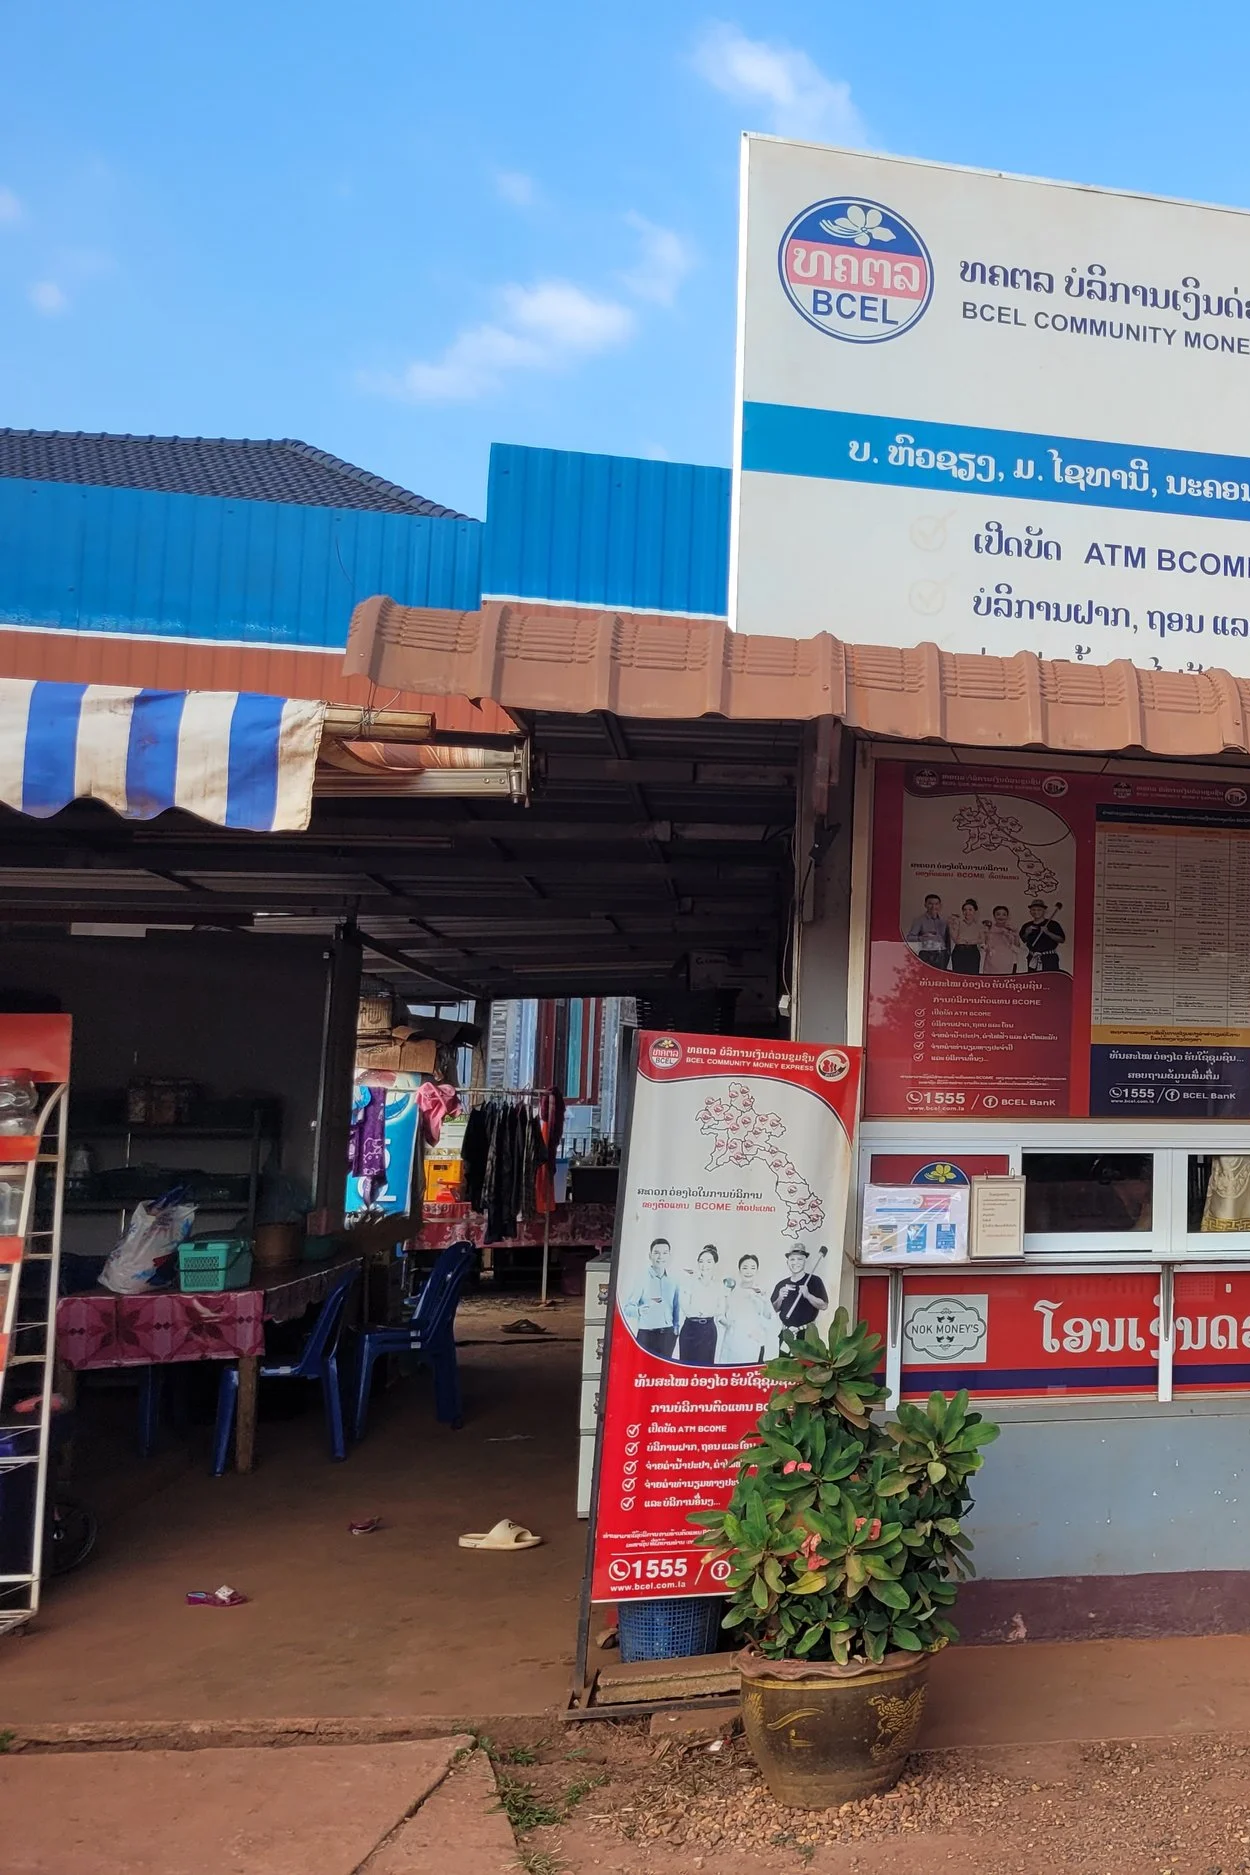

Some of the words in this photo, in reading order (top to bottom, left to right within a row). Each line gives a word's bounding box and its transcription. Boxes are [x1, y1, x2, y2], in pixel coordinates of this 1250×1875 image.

[793, 247, 920, 292] ທຄຕລ
[959, 259, 1054, 295] ທຄຕລ
[812, 289, 899, 325] BCEL
[962, 301, 1026, 327] BCEL
[1034, 310, 1178, 346] COMMUNITY
[973, 520, 1062, 560] ເປີດບັດ
[1084, 541, 1146, 570] ATM
[1147, 609, 1204, 638] ຖອນ
[655, 1057, 674, 1065] BCEL
[707, 1059, 750, 1067] COMMUNITY
[781, 1064, 815, 1072] EXPRESS
[924, 1092, 965, 1104] 1555
[1122, 1088, 1155, 1098] 1555
[1182, 1091, 1208, 1099] BCEL
[694, 1203, 731, 1211] BCOME
[911, 1324, 933, 1334] NOK
[936, 1323, 979, 1334] MONEY'S
[677, 1425, 696, 1433] ATM
[698, 1425, 727, 1433] BCOME
[631, 1558, 687, 1579] 1555
[610, 1581, 686, 1592] www.bcel.com.la
